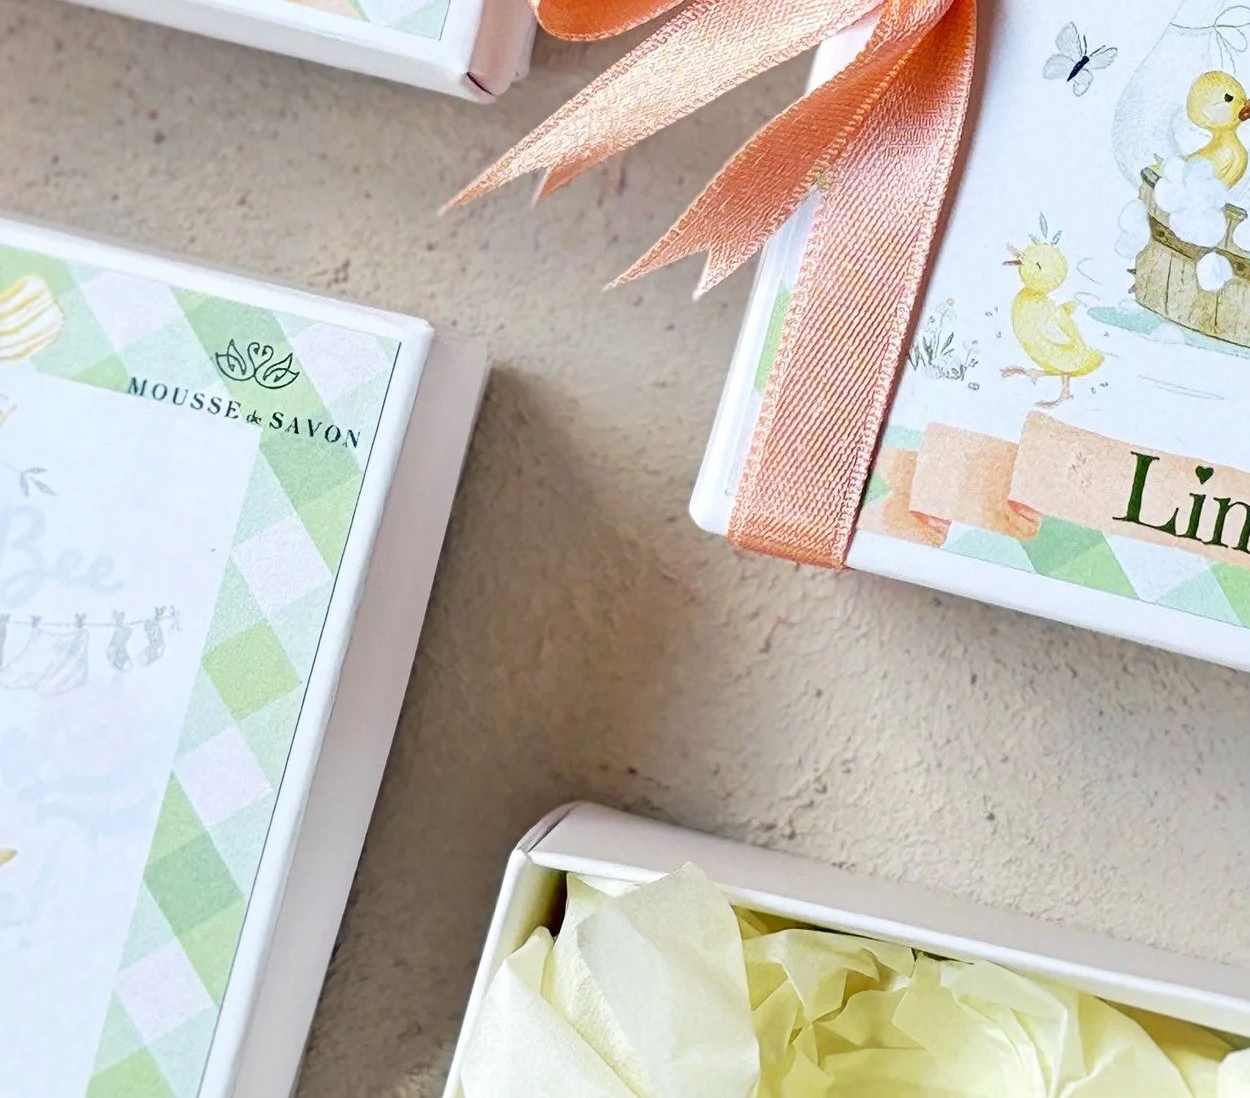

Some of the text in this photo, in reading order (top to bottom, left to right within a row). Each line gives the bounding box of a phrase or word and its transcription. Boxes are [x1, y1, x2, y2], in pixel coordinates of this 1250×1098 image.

[127, 377, 361, 448] MOUSSE de SAVON
